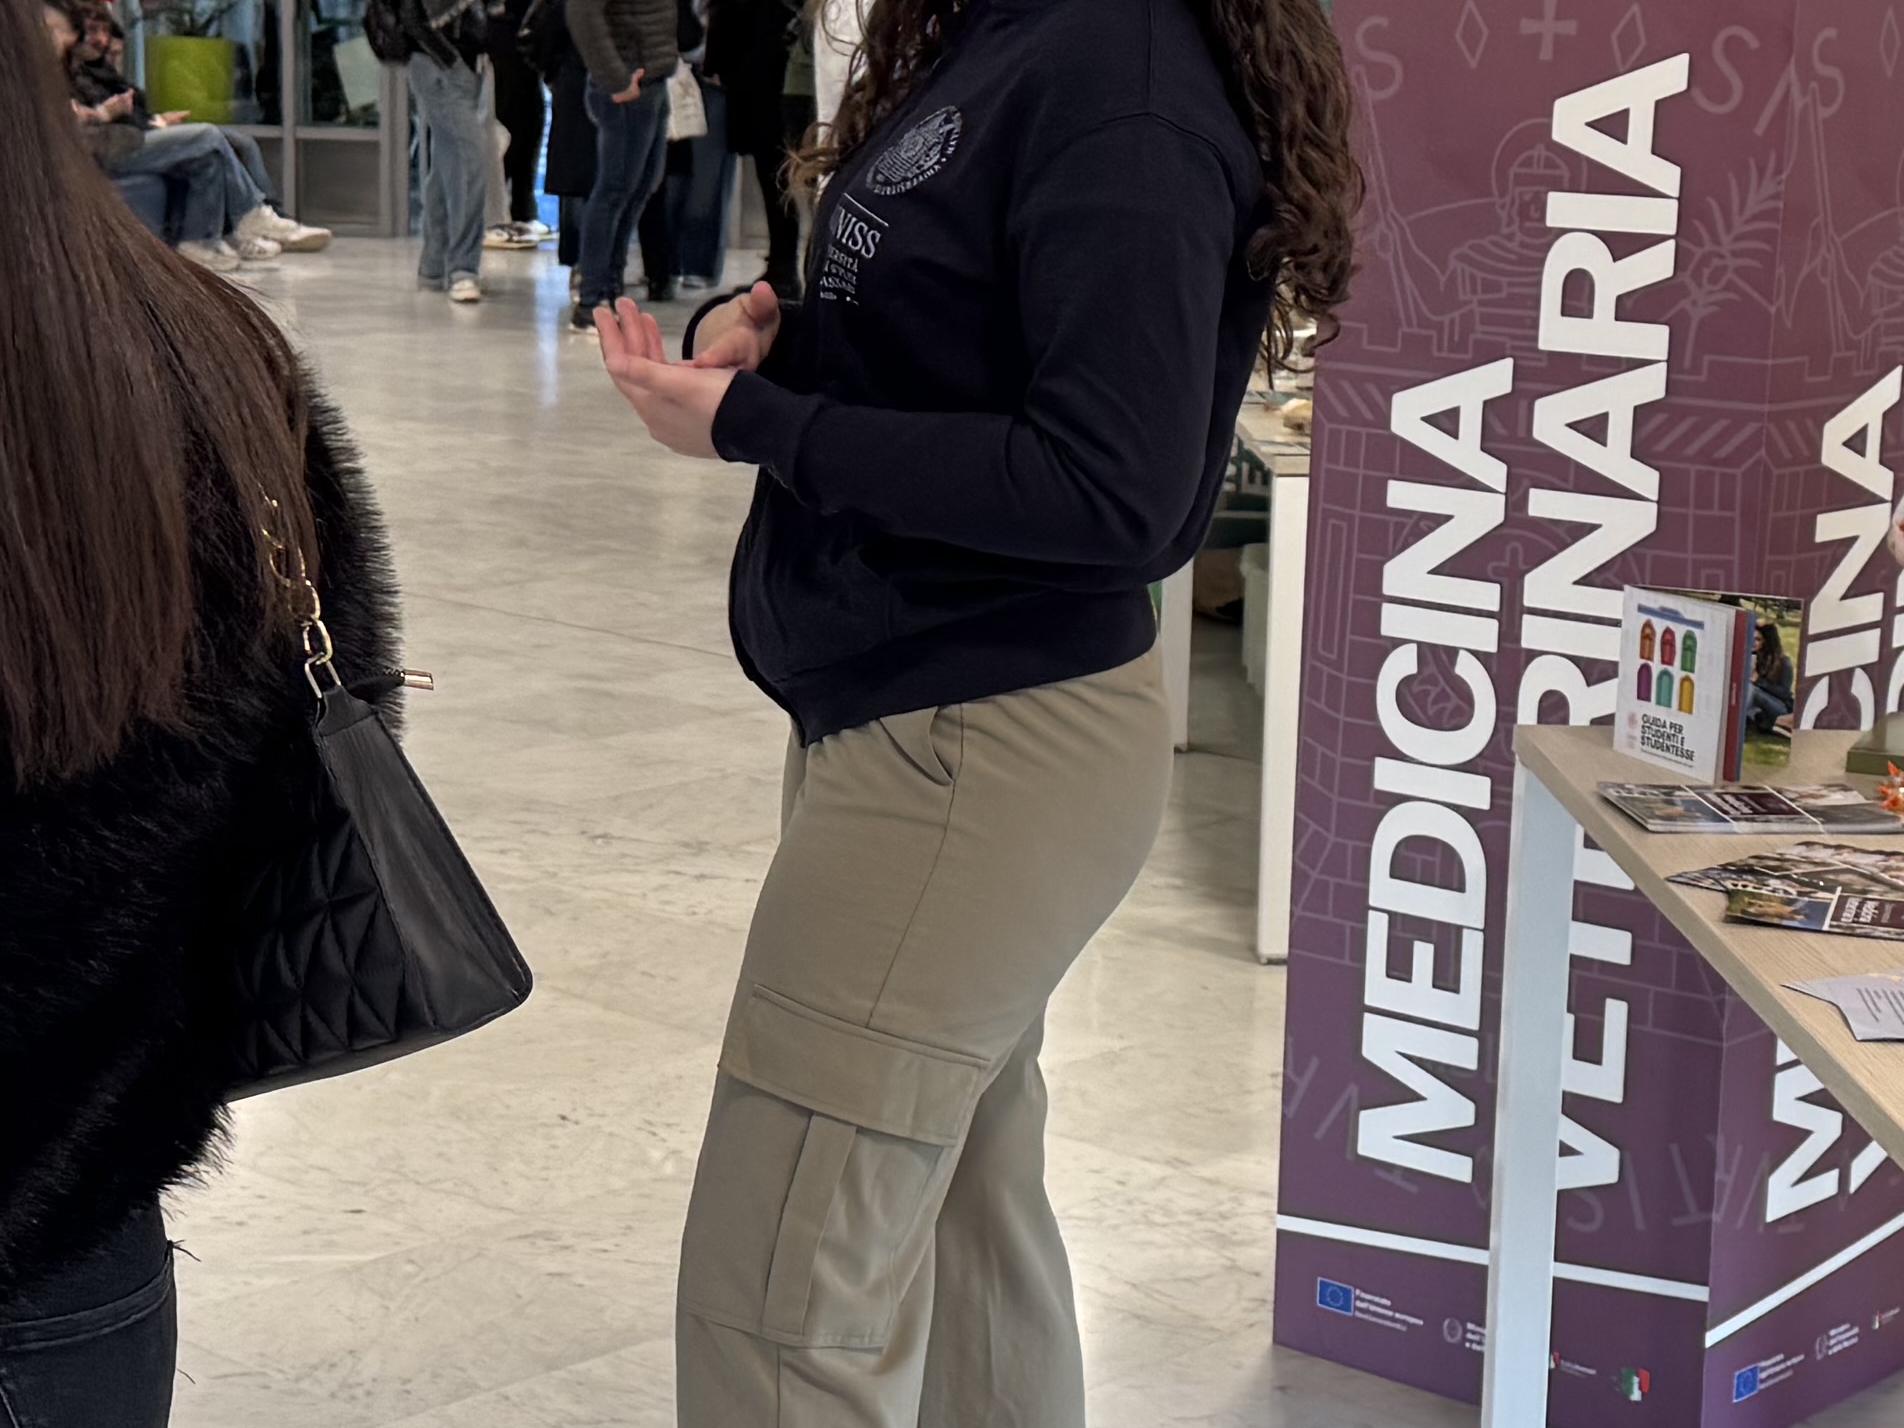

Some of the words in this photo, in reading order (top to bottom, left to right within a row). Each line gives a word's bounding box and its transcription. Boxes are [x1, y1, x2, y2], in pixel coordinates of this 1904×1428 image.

[1641, 714, 1667, 730] GUIDA
[1669, 721, 1684, 735] PER
[1641, 724, 1680, 746] STUDENTI
[1640, 735, 1695, 762] STUDENTESSE
[1357, 357, 1513, 1183] MEDICINA
